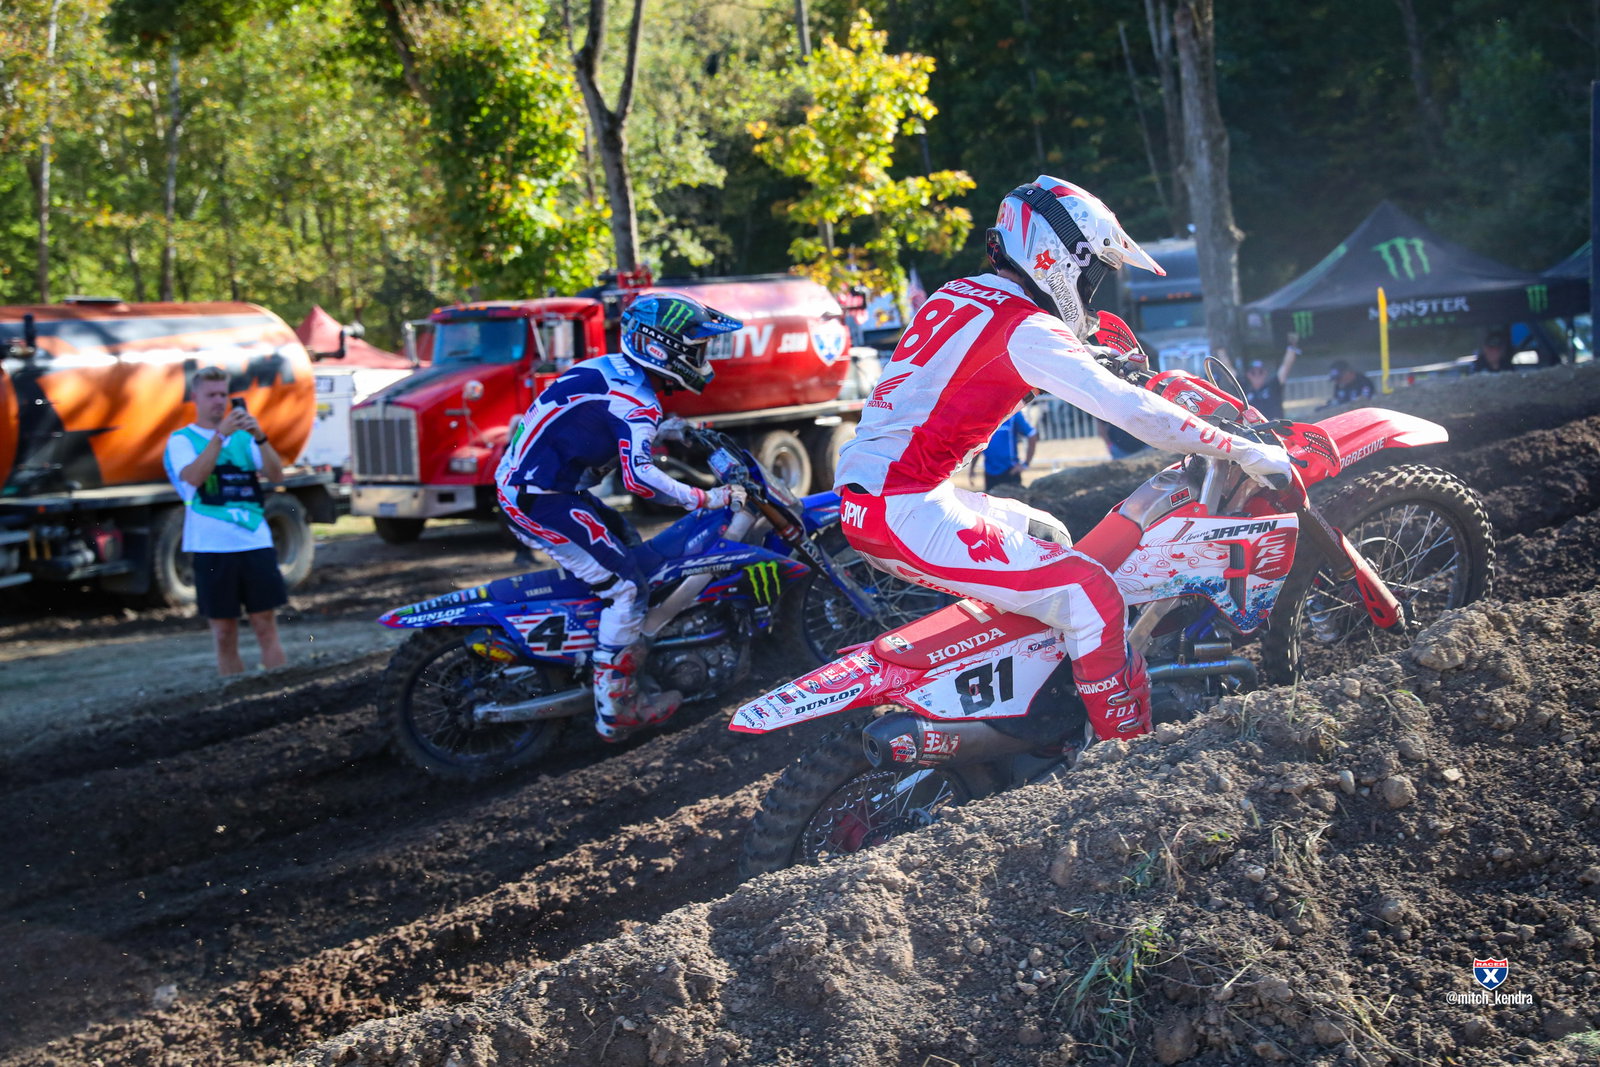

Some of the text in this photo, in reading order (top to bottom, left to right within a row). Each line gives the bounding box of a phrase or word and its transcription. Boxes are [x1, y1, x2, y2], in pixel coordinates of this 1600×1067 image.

[1369, 297, 1470, 320] MONSTER
[642, 327, 689, 353] OAKLEY
[891, 298, 984, 367] 81
[649, 346, 664, 359] BELL
[867, 400, 893, 411] HONDA
[1180, 416, 1233, 453] FOX
[1339, 436, 1386, 470] OGRESSIVE
[841, 501, 868, 529] JPN
[1204, 520, 1278, 541] JAPAN
[1039, 549, 1070, 562] HONDA
[401, 607, 466, 625] DUNLOP
[527, 614, 570, 651] 4
[926, 627, 1006, 665] HONDA
[956, 656, 1014, 716] 81
[794, 686, 861, 715] DUNLOP
[1105, 703, 1136, 719] FOX
